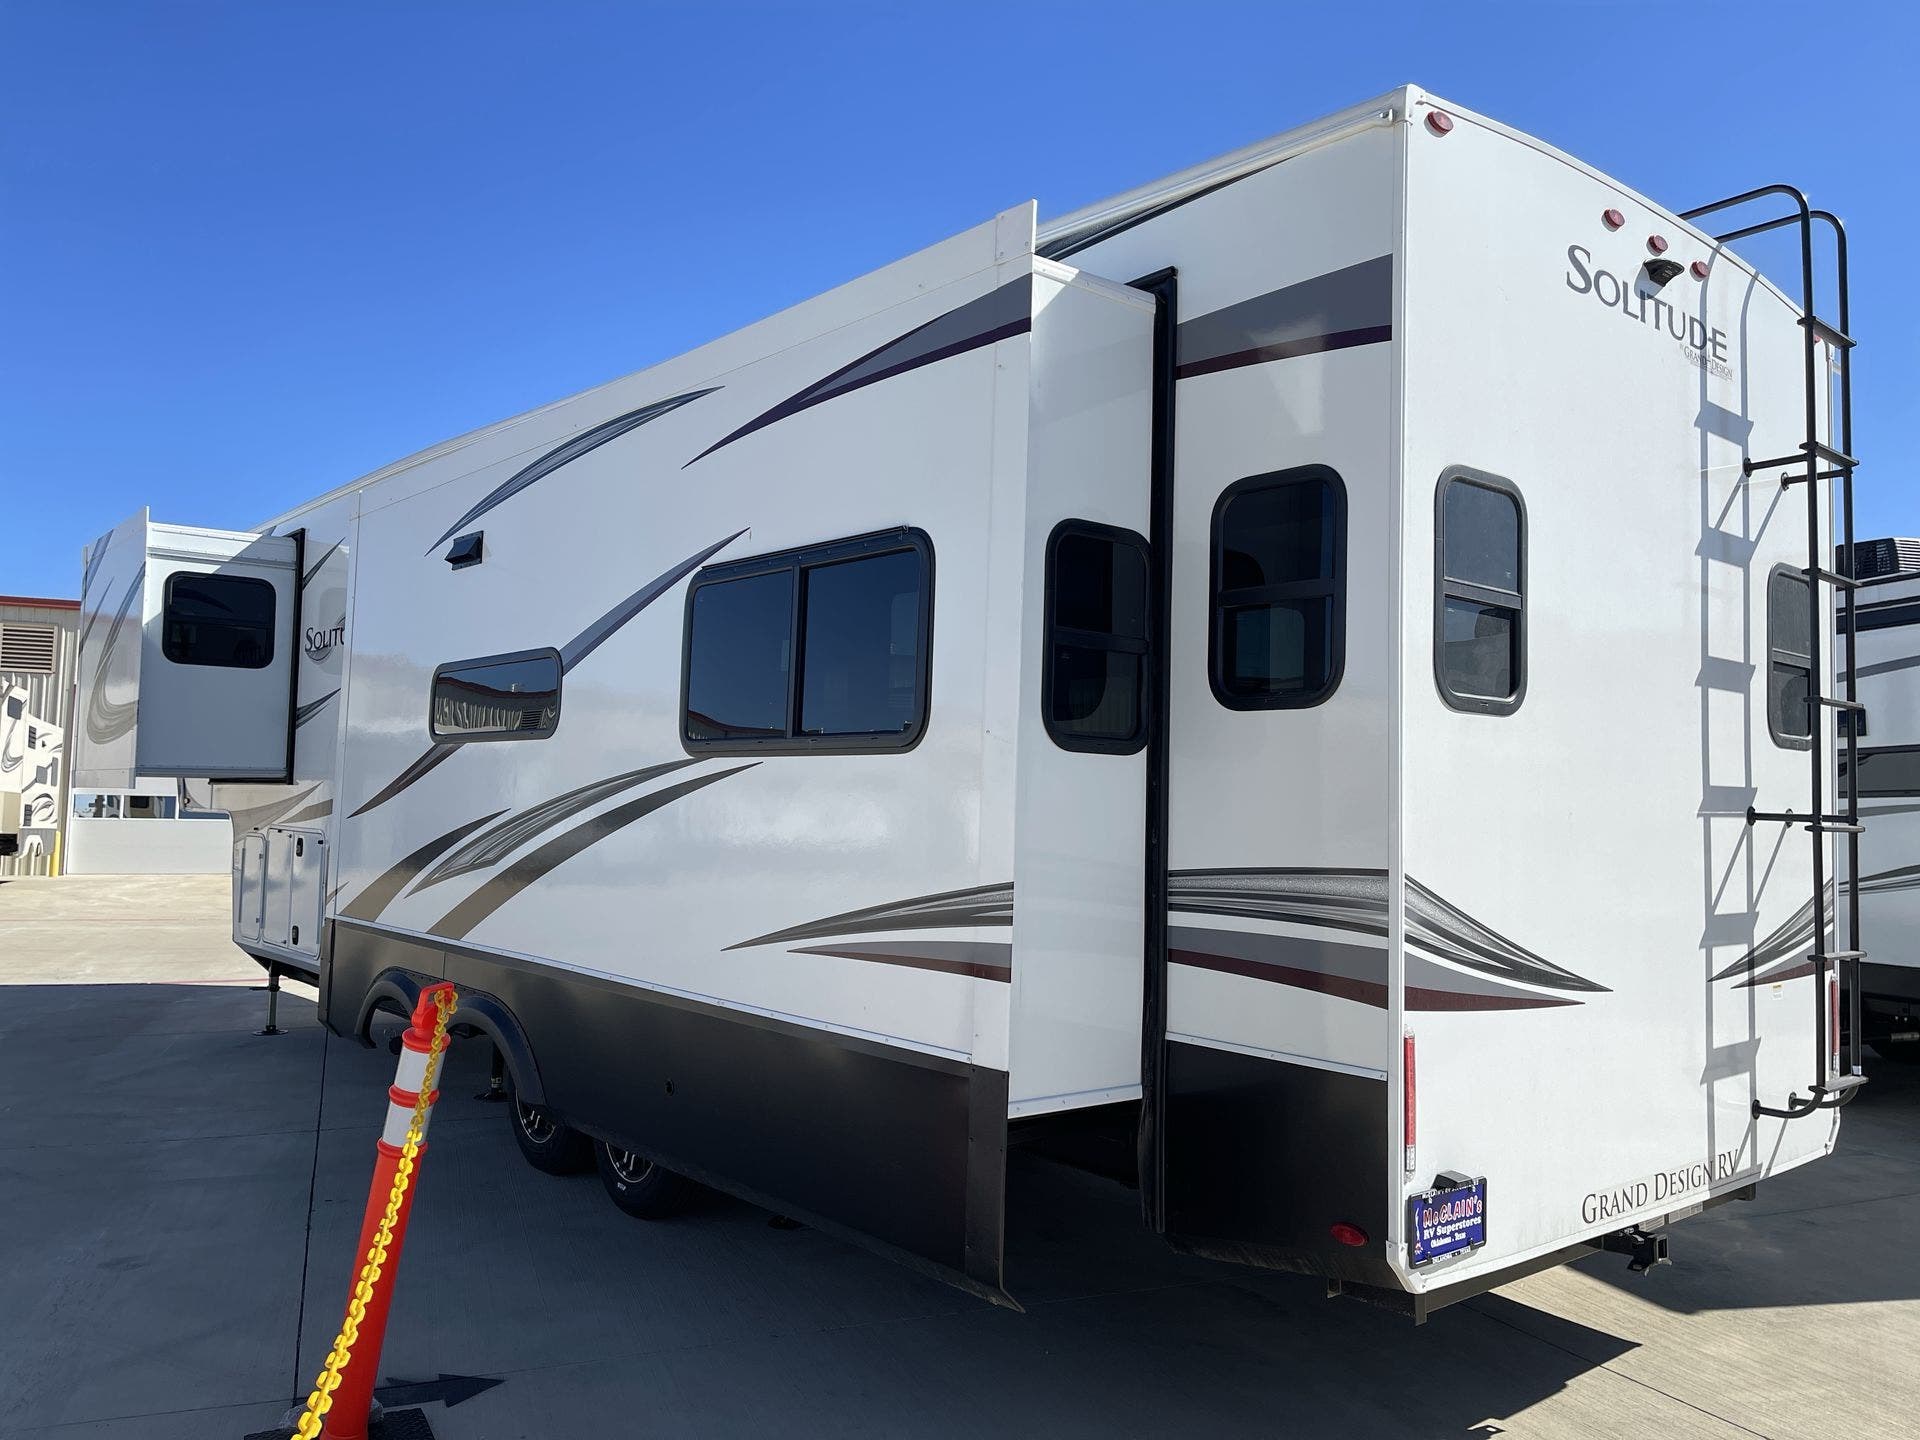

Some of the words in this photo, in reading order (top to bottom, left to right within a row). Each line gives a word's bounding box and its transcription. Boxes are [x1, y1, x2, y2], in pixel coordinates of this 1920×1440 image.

[1566, 244, 1728, 362] SOLITUDE
[1582, 1182, 1648, 1224] GRAND
[1654, 1160, 1714, 1201] DESIGN
[1718, 1149, 1739, 1180] RV
[1423, 1227, 1436, 1240] RV
[1436, 1216, 1482, 1236] Superstores
